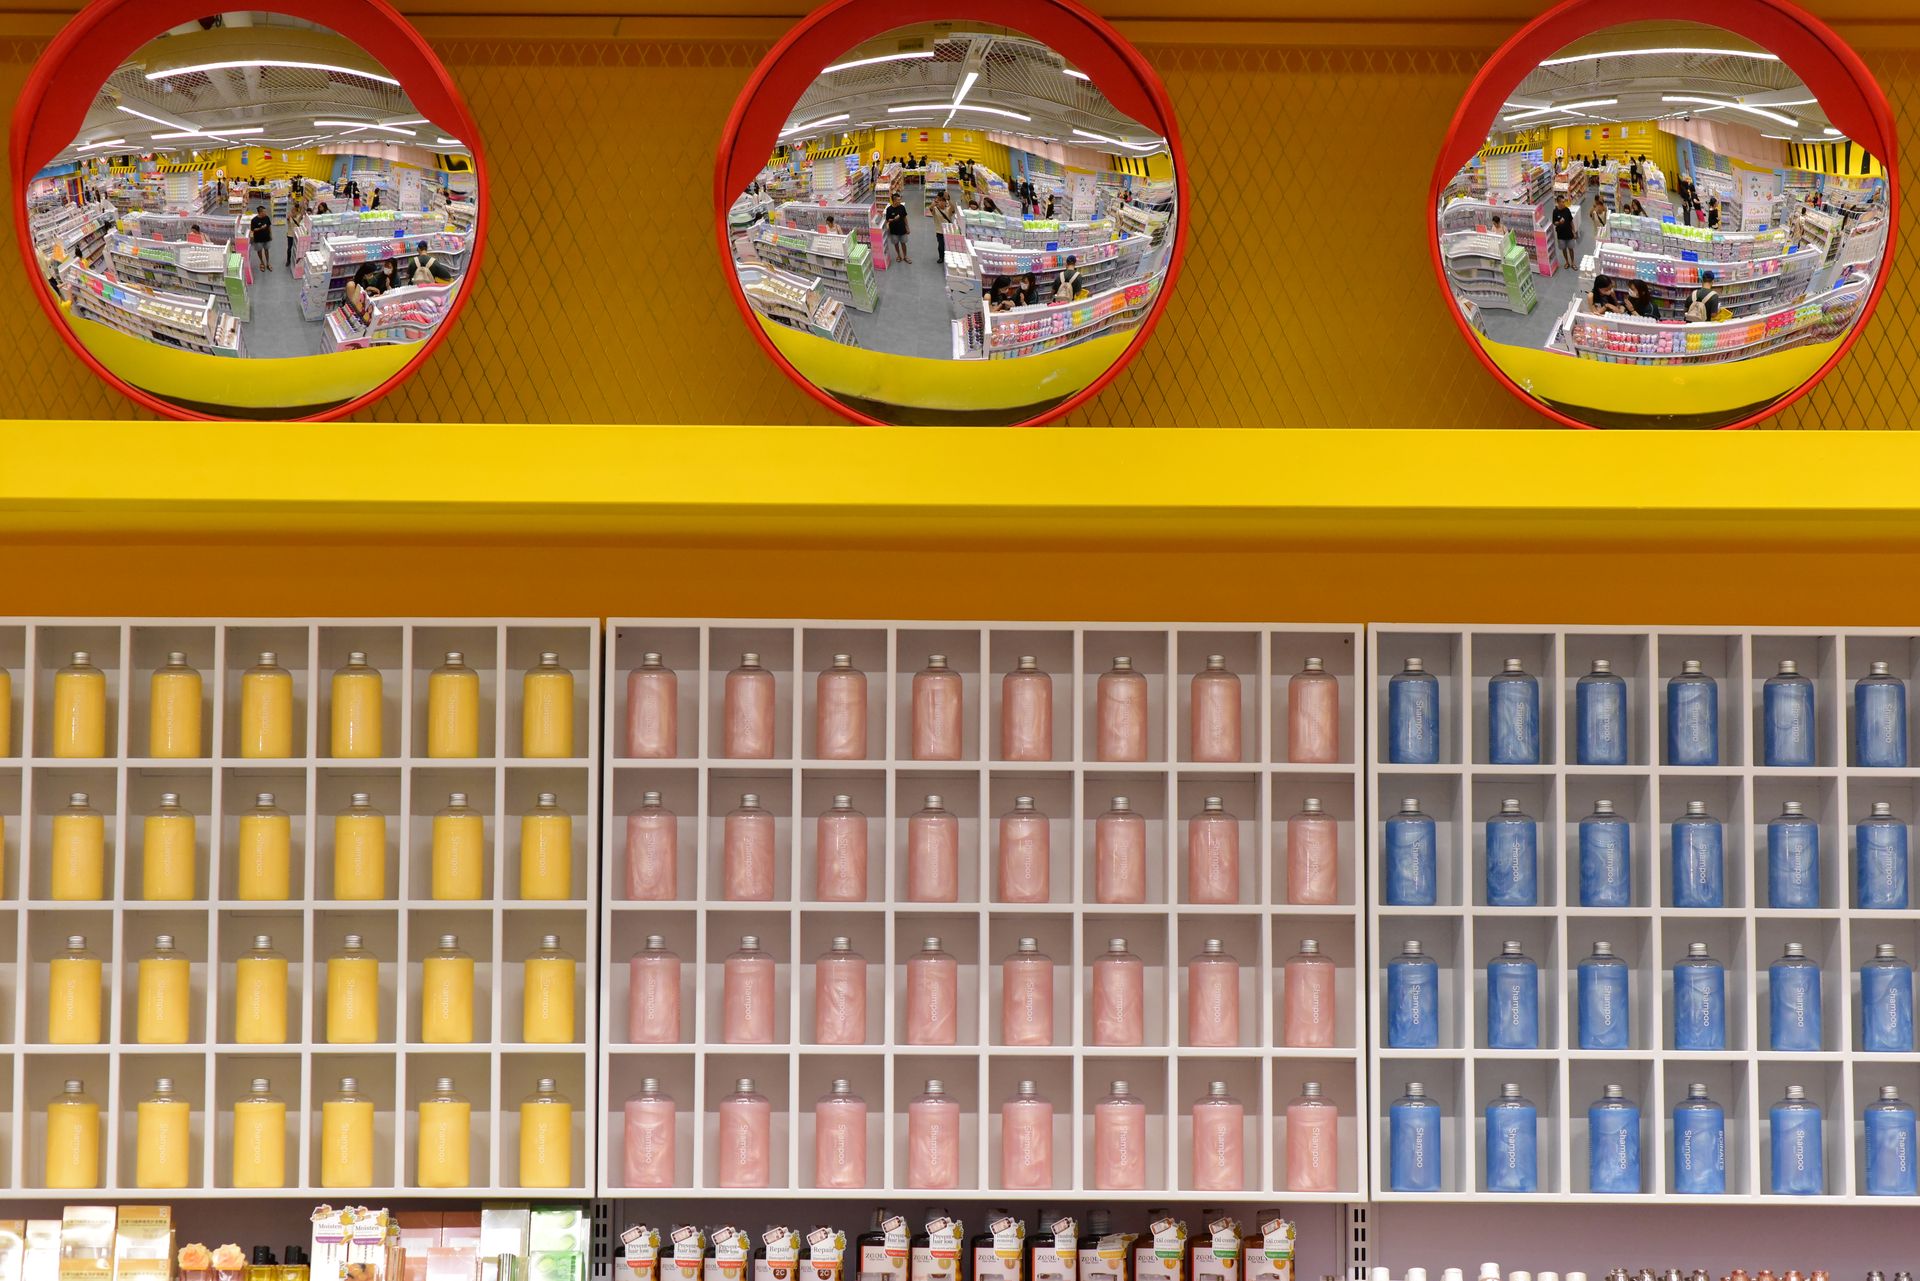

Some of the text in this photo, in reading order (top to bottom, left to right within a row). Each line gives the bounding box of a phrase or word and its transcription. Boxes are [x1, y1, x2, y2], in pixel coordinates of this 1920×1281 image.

[1415, 701, 1424, 740] Shampoo
[1792, 704, 1801, 743] Shampoo
[1884, 704, 1893, 743] Shampoo
[1412, 842, 1421, 881] Shampoo
[1512, 843, 1521, 882] Shampoo
[1607, 844, 1616, 883] Shampoo
[1699, 844, 1708, 884] Shampoo
[1411, 985, 1421, 1024] Shampoo
[1511, 986, 1521, 1025] Shampoo
[1603, 986, 1612, 1026] Shampoo
[1702, 987, 1711, 1026] Shampoo
[1796, 987, 1805, 1027] Shampoo
[1887, 988, 1898, 1028] Shampoo
[1415, 1128, 1424, 1168] Shampoo
[1508, 1127, 1518, 1168] Shampoo
[1618, 1129, 1628, 1169] Shampoo
[1684, 1130, 1692, 1170] Shampoo
[1795, 1130, 1805, 1171] Shampoo
[1898, 1131, 1907, 1171] Shampoo
[813, 1246, 833, 1254] Repair
